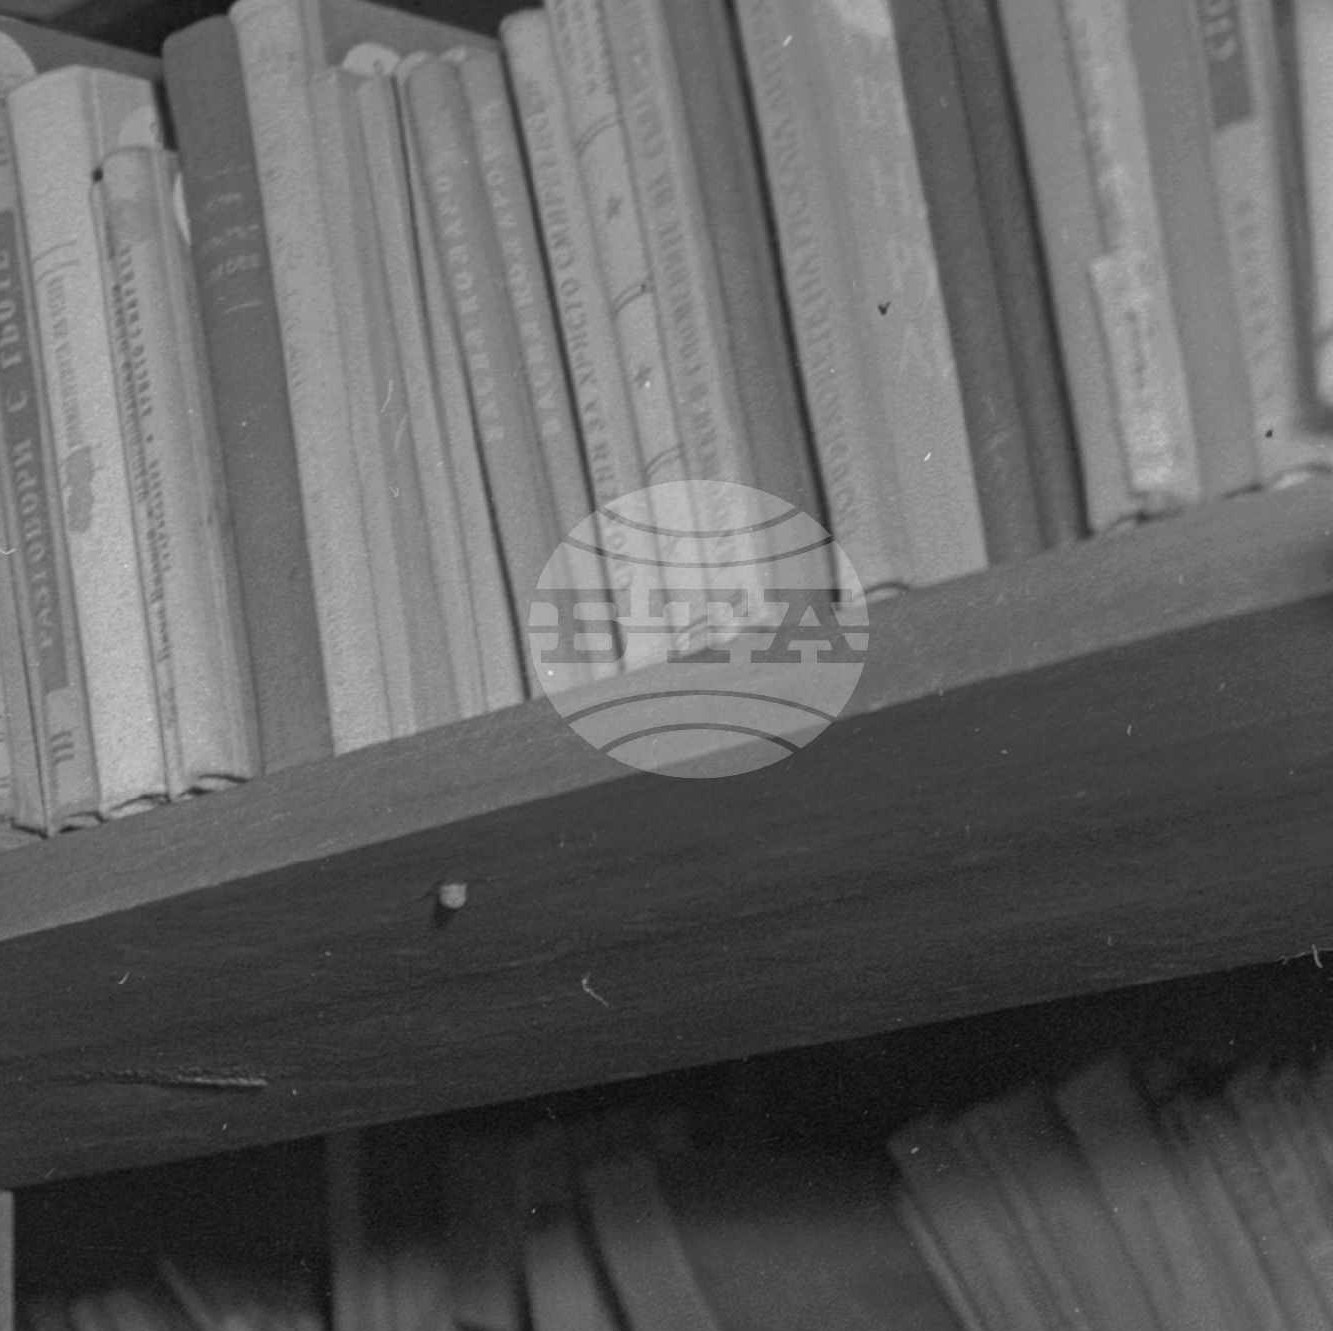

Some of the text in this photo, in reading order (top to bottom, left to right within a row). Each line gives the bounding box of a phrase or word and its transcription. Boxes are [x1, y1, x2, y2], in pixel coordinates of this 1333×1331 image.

[464, 321, 505, 447] ВАСИЛ
[519, 312, 564, 441] ВАСИЛ
[558, 272, 597, 392] ХРИСТО
[3, 387, 32, 412] С
[11, 439, 70, 650] РАЗГОВОРИ
